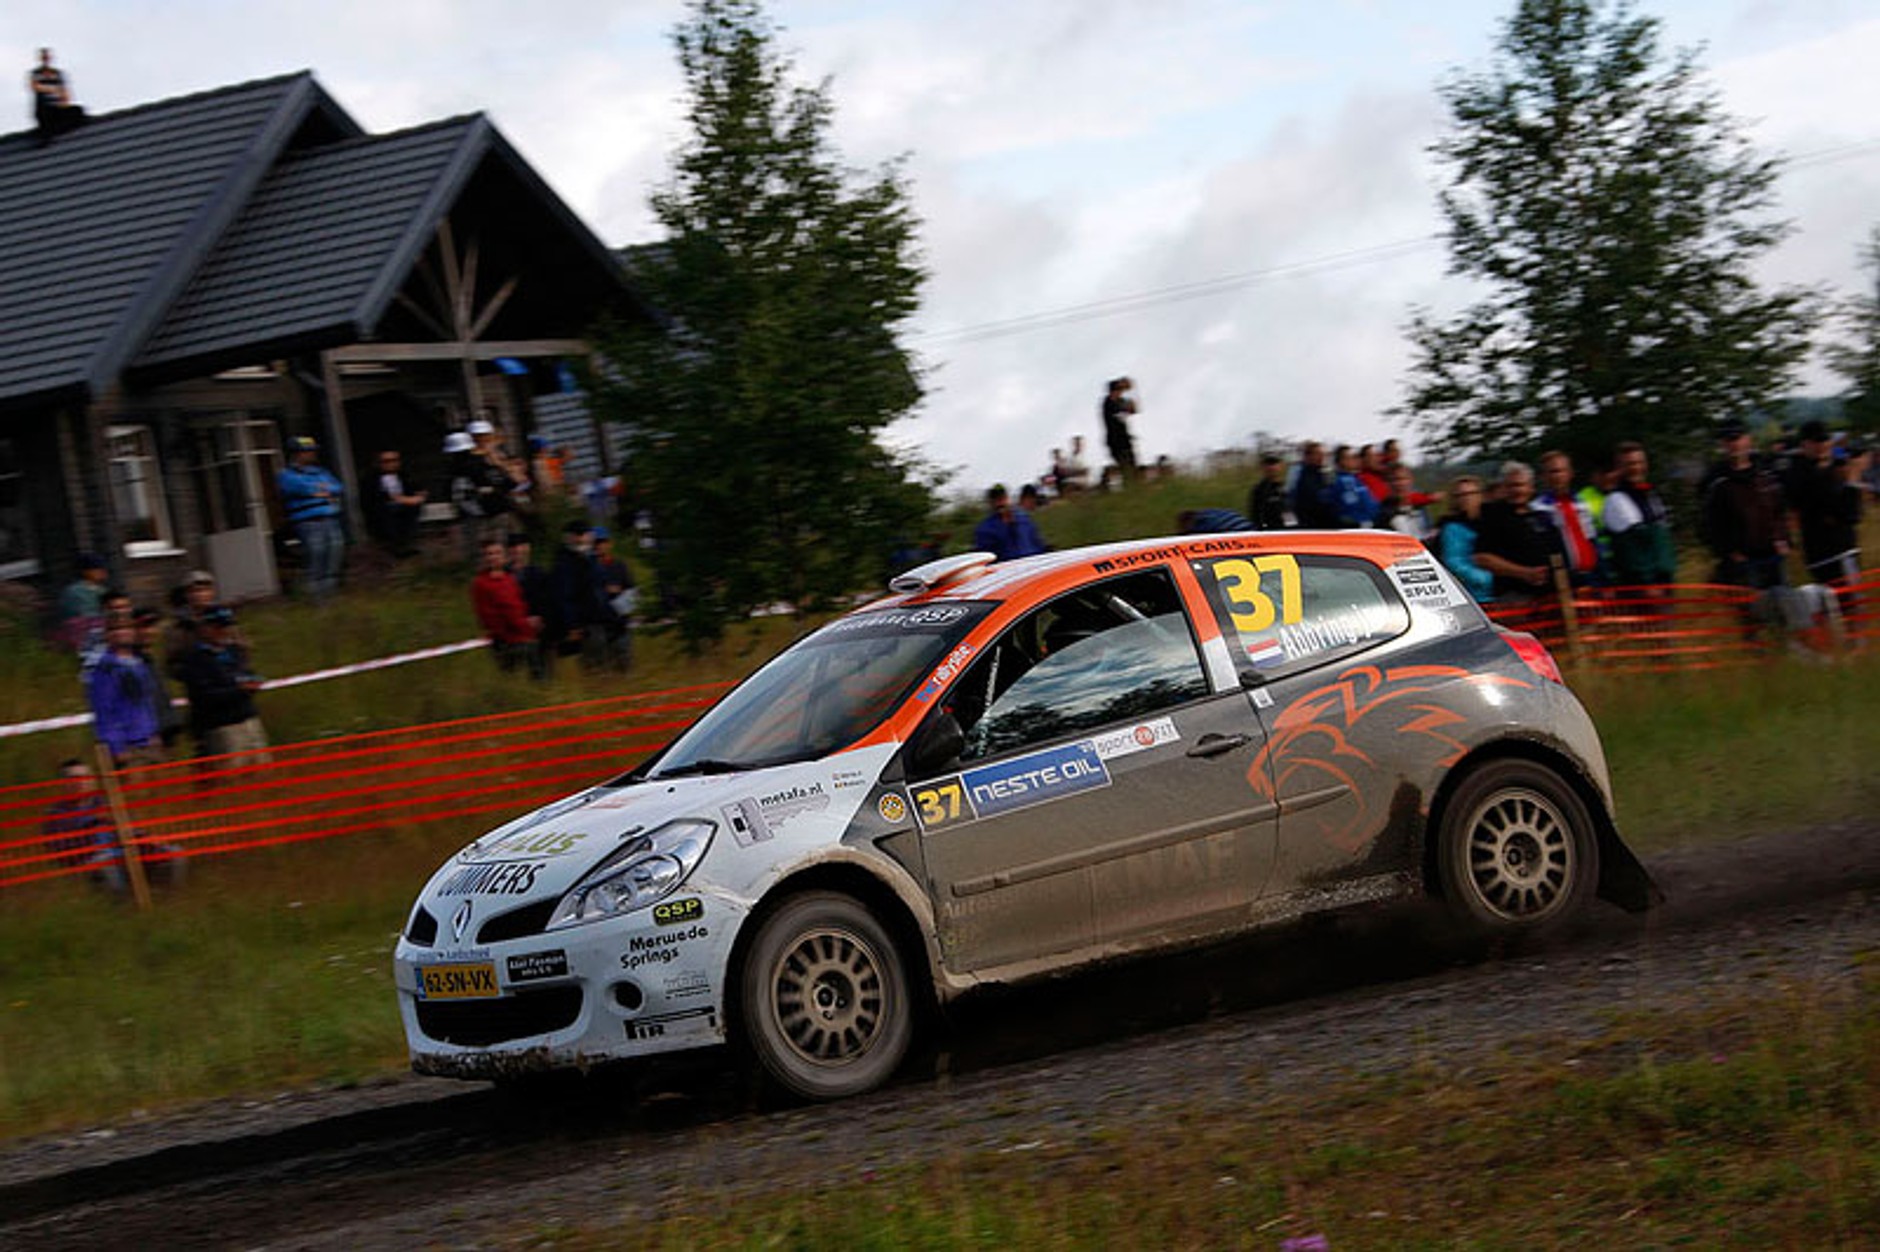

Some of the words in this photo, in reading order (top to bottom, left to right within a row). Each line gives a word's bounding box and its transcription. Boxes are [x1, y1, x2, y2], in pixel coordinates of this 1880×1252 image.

[1213, 554, 1303, 631] 37
[916, 784, 962, 826] 37
[972, 766, 1062, 804] NESTE
[1061, 758, 1101, 779] OIL
[655, 899, 699, 918] QSP
[424, 969, 495, 993] 62-SN-VX
